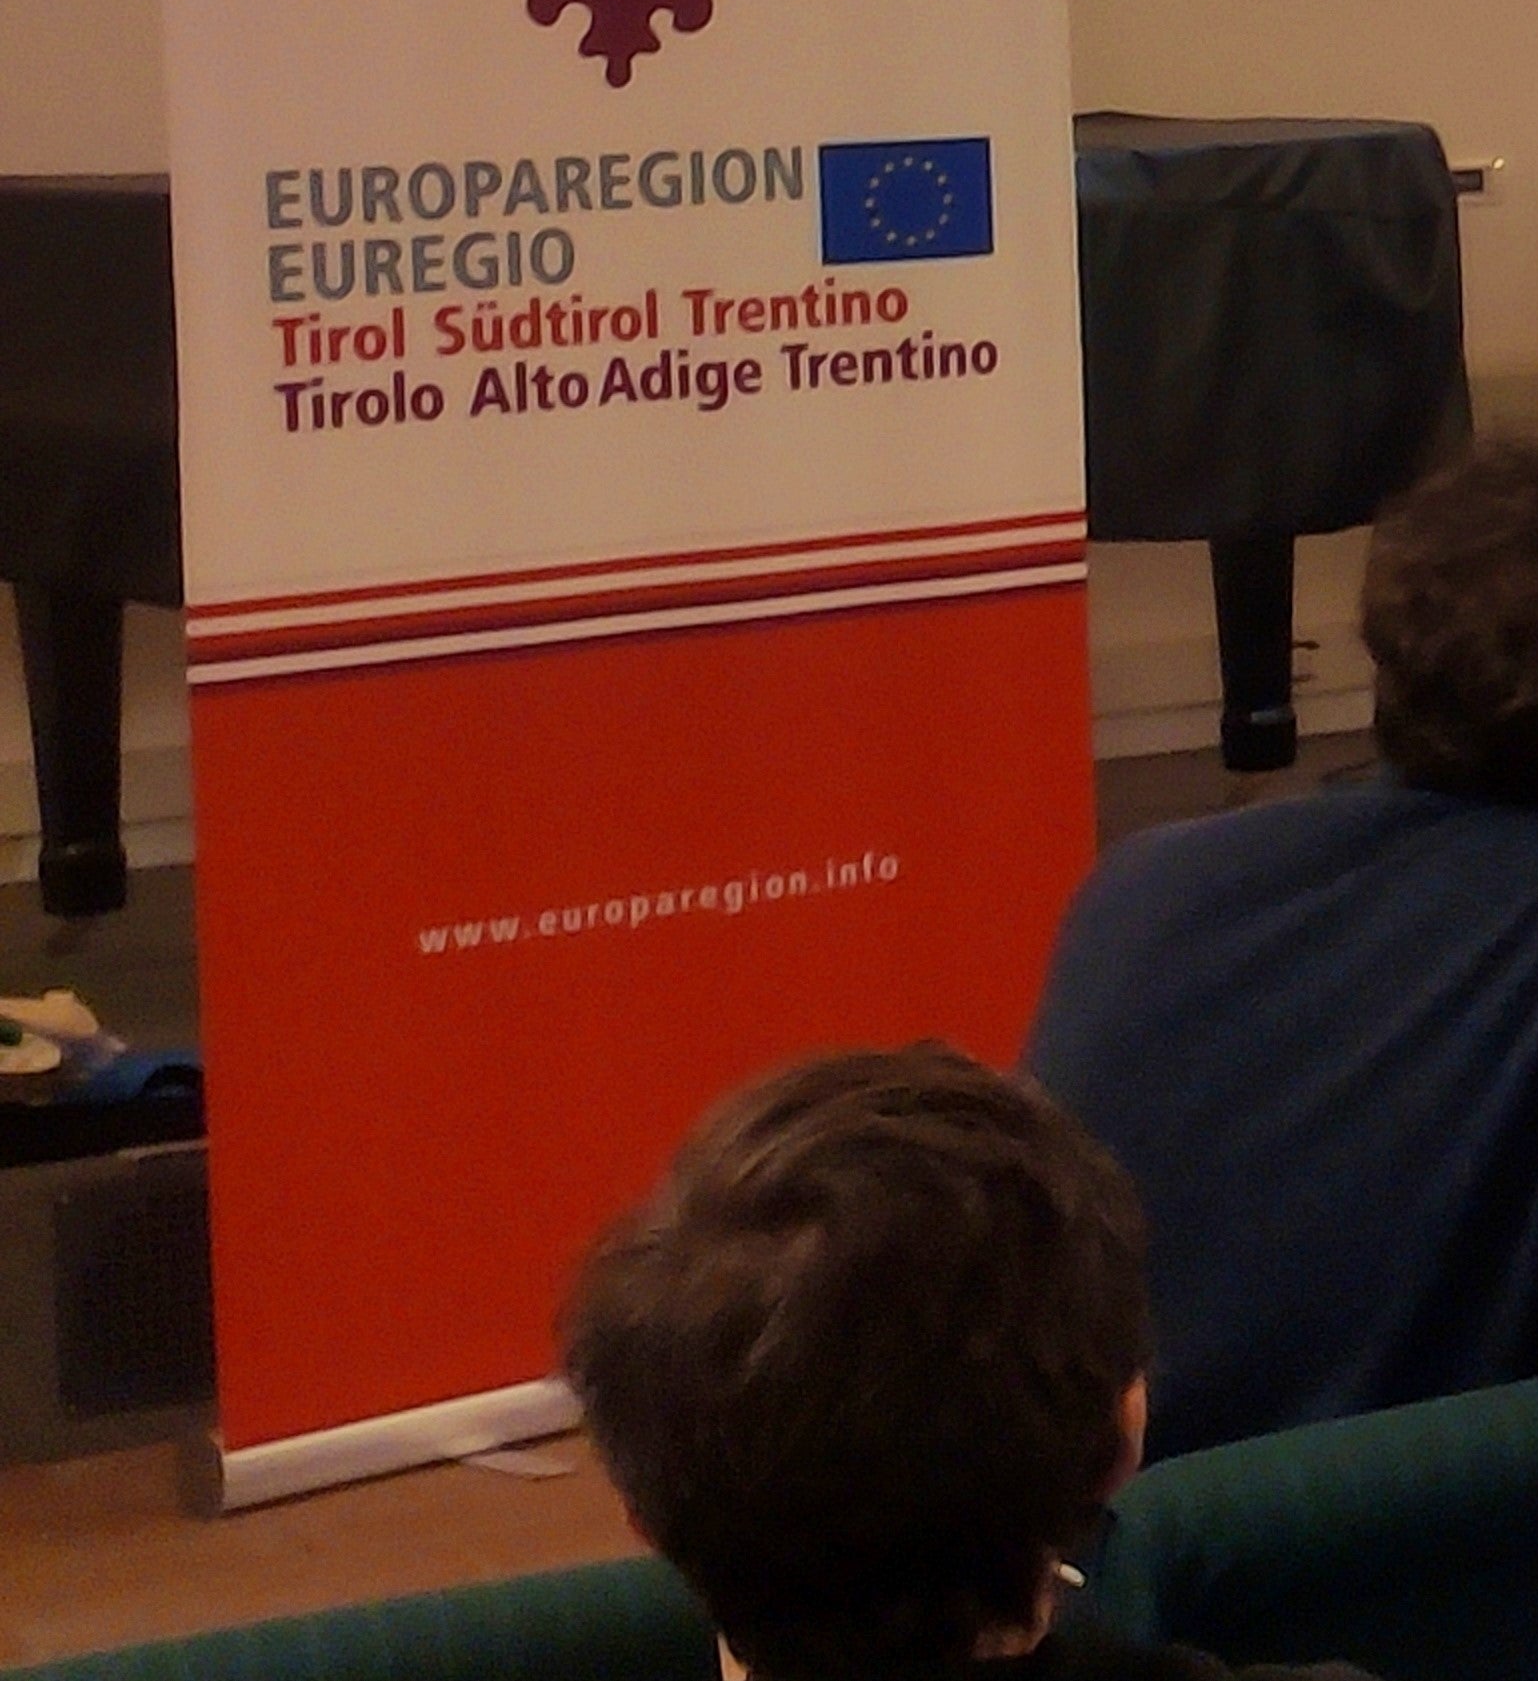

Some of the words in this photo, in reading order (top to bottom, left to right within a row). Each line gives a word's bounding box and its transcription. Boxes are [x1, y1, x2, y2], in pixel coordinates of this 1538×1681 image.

[264, 145, 803, 229] EUROPAREGION
[267, 227, 576, 303] EUREGIO
[272, 307, 405, 367] Tirol
[433, 287, 659, 356] Südtirol
[681, 277, 909, 335] Trentino
[274, 370, 445, 432] Tirolo
[470, 361, 589, 416] Alto
[598, 349, 763, 411] Adige
[780, 330, 999, 390] Trentino
[419, 851, 899, 953] www.europaregion.info
